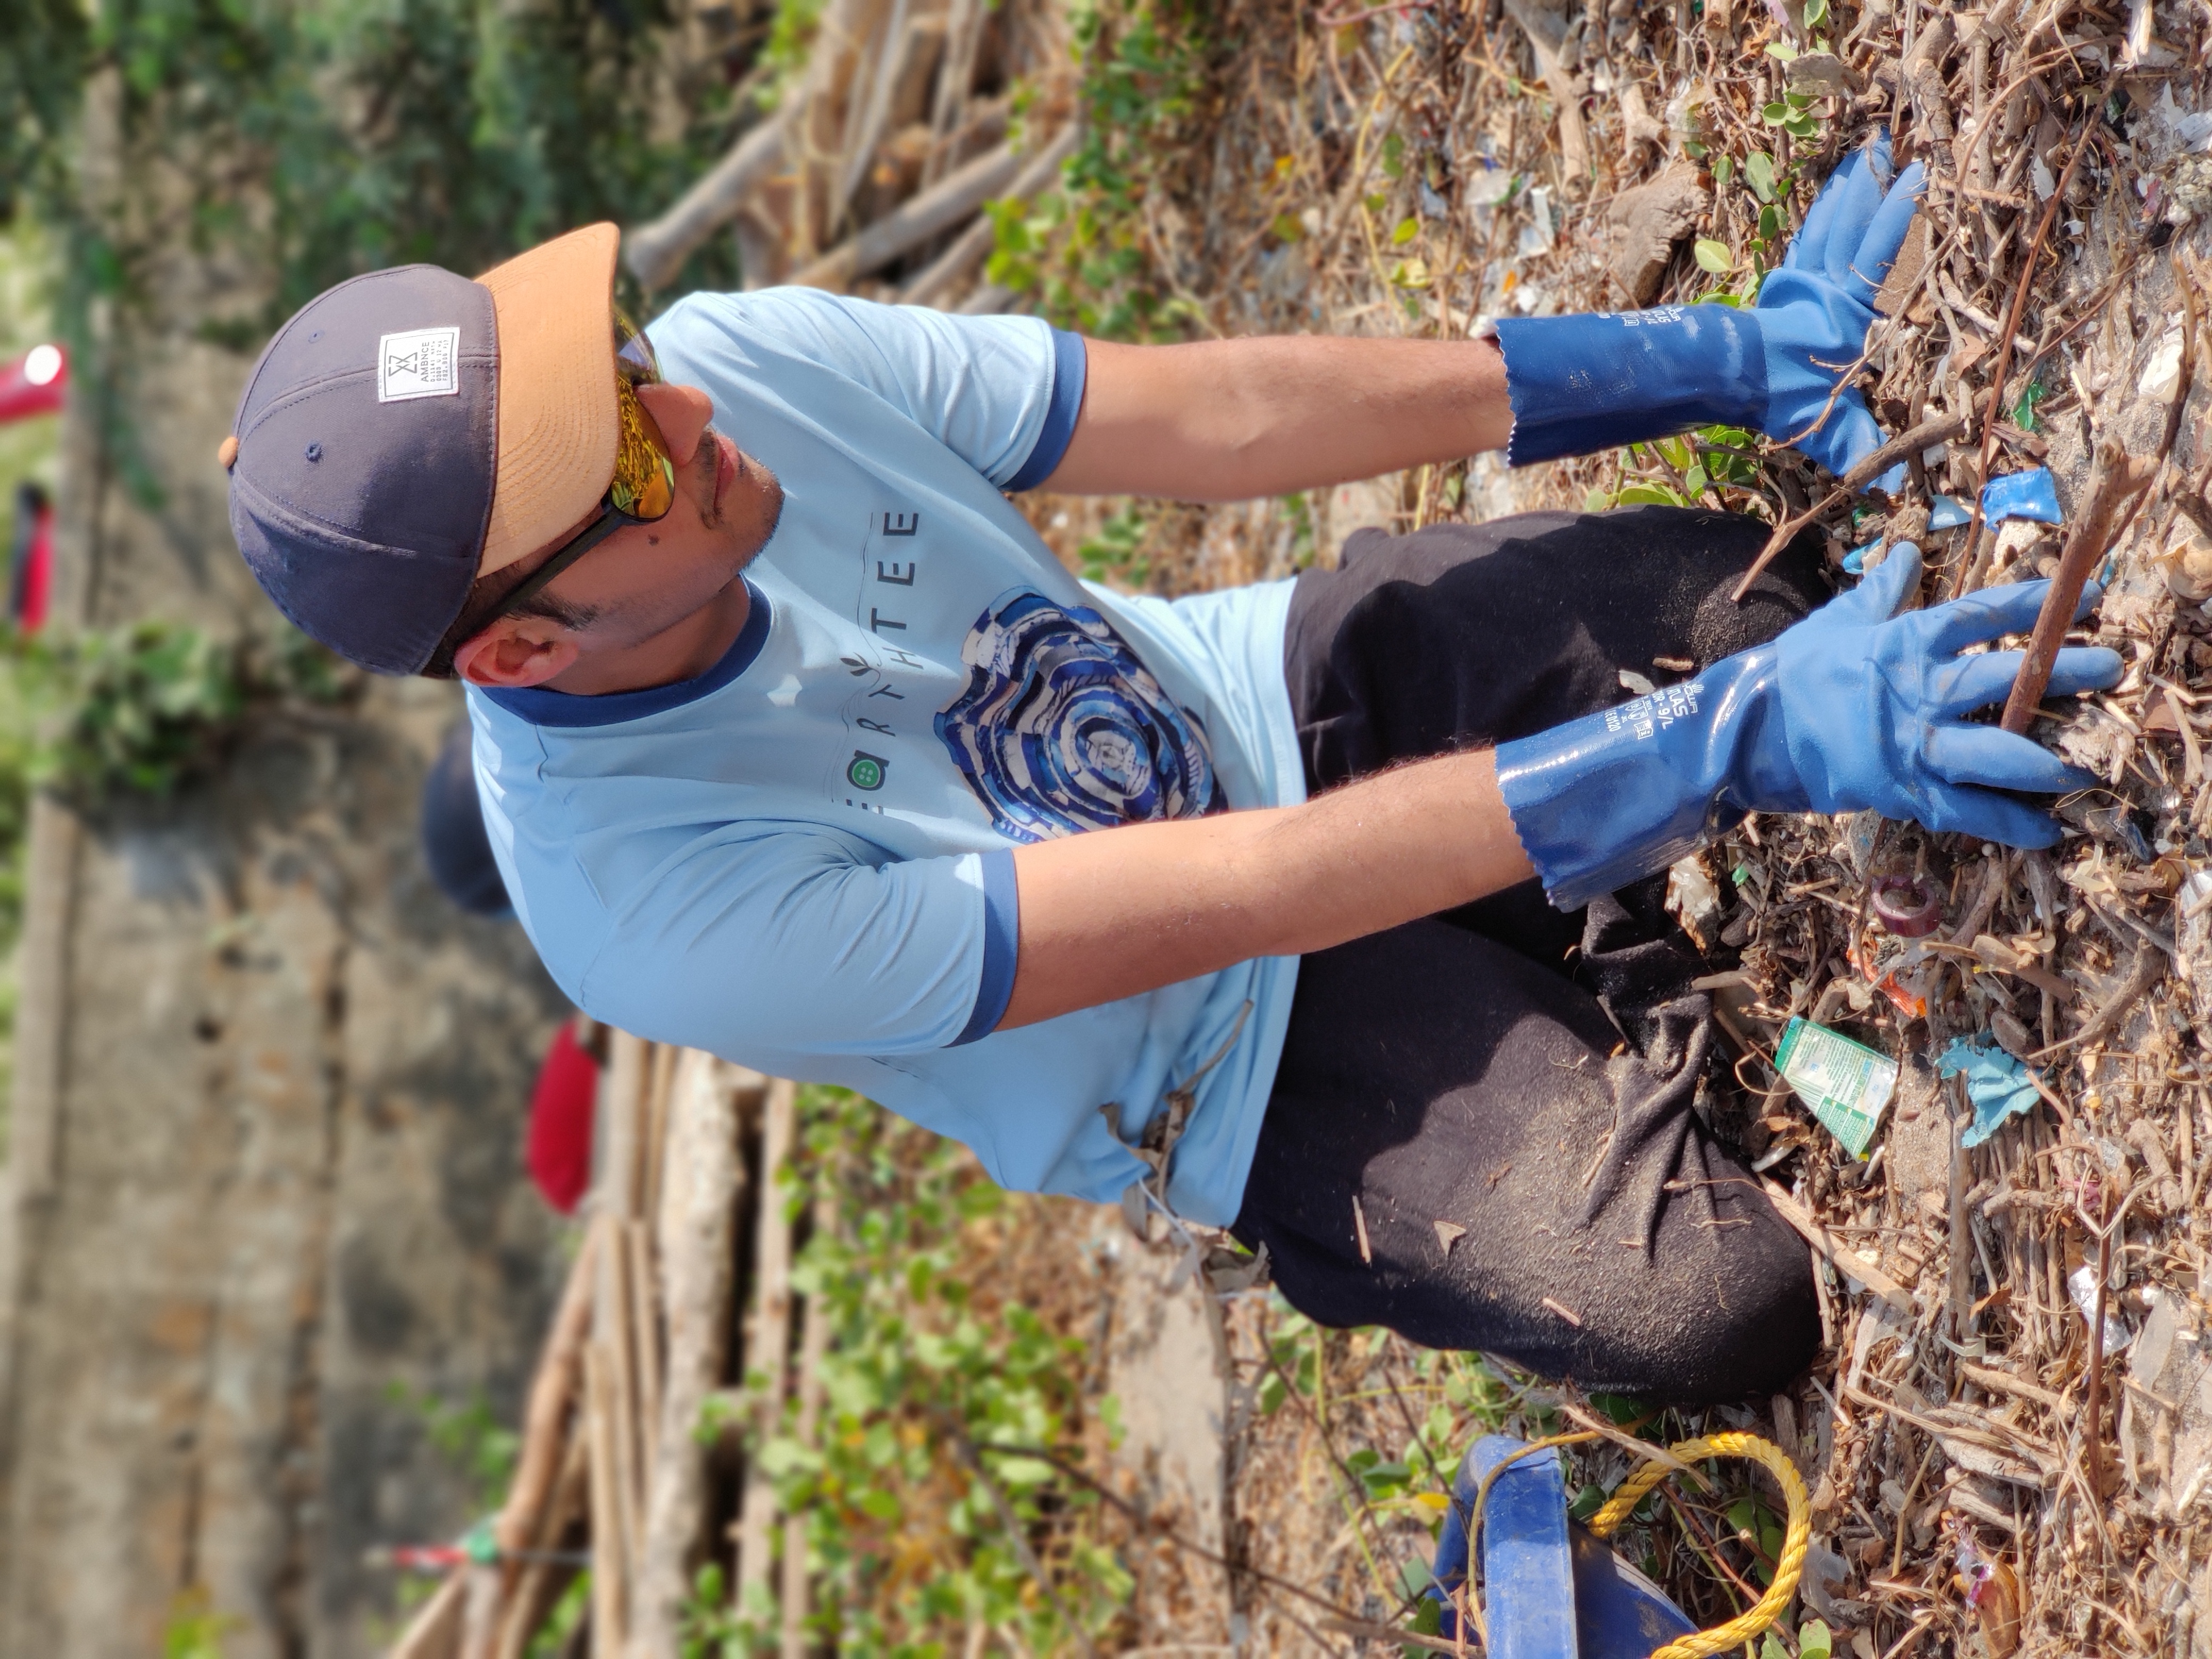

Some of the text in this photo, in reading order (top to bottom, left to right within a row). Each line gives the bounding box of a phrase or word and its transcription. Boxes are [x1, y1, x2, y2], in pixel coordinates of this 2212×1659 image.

[420, 341, 430, 382] AMBNCE
[1666, 688, 1688, 717] ATLAS
[1657, 708, 1674, 730] 9/L
